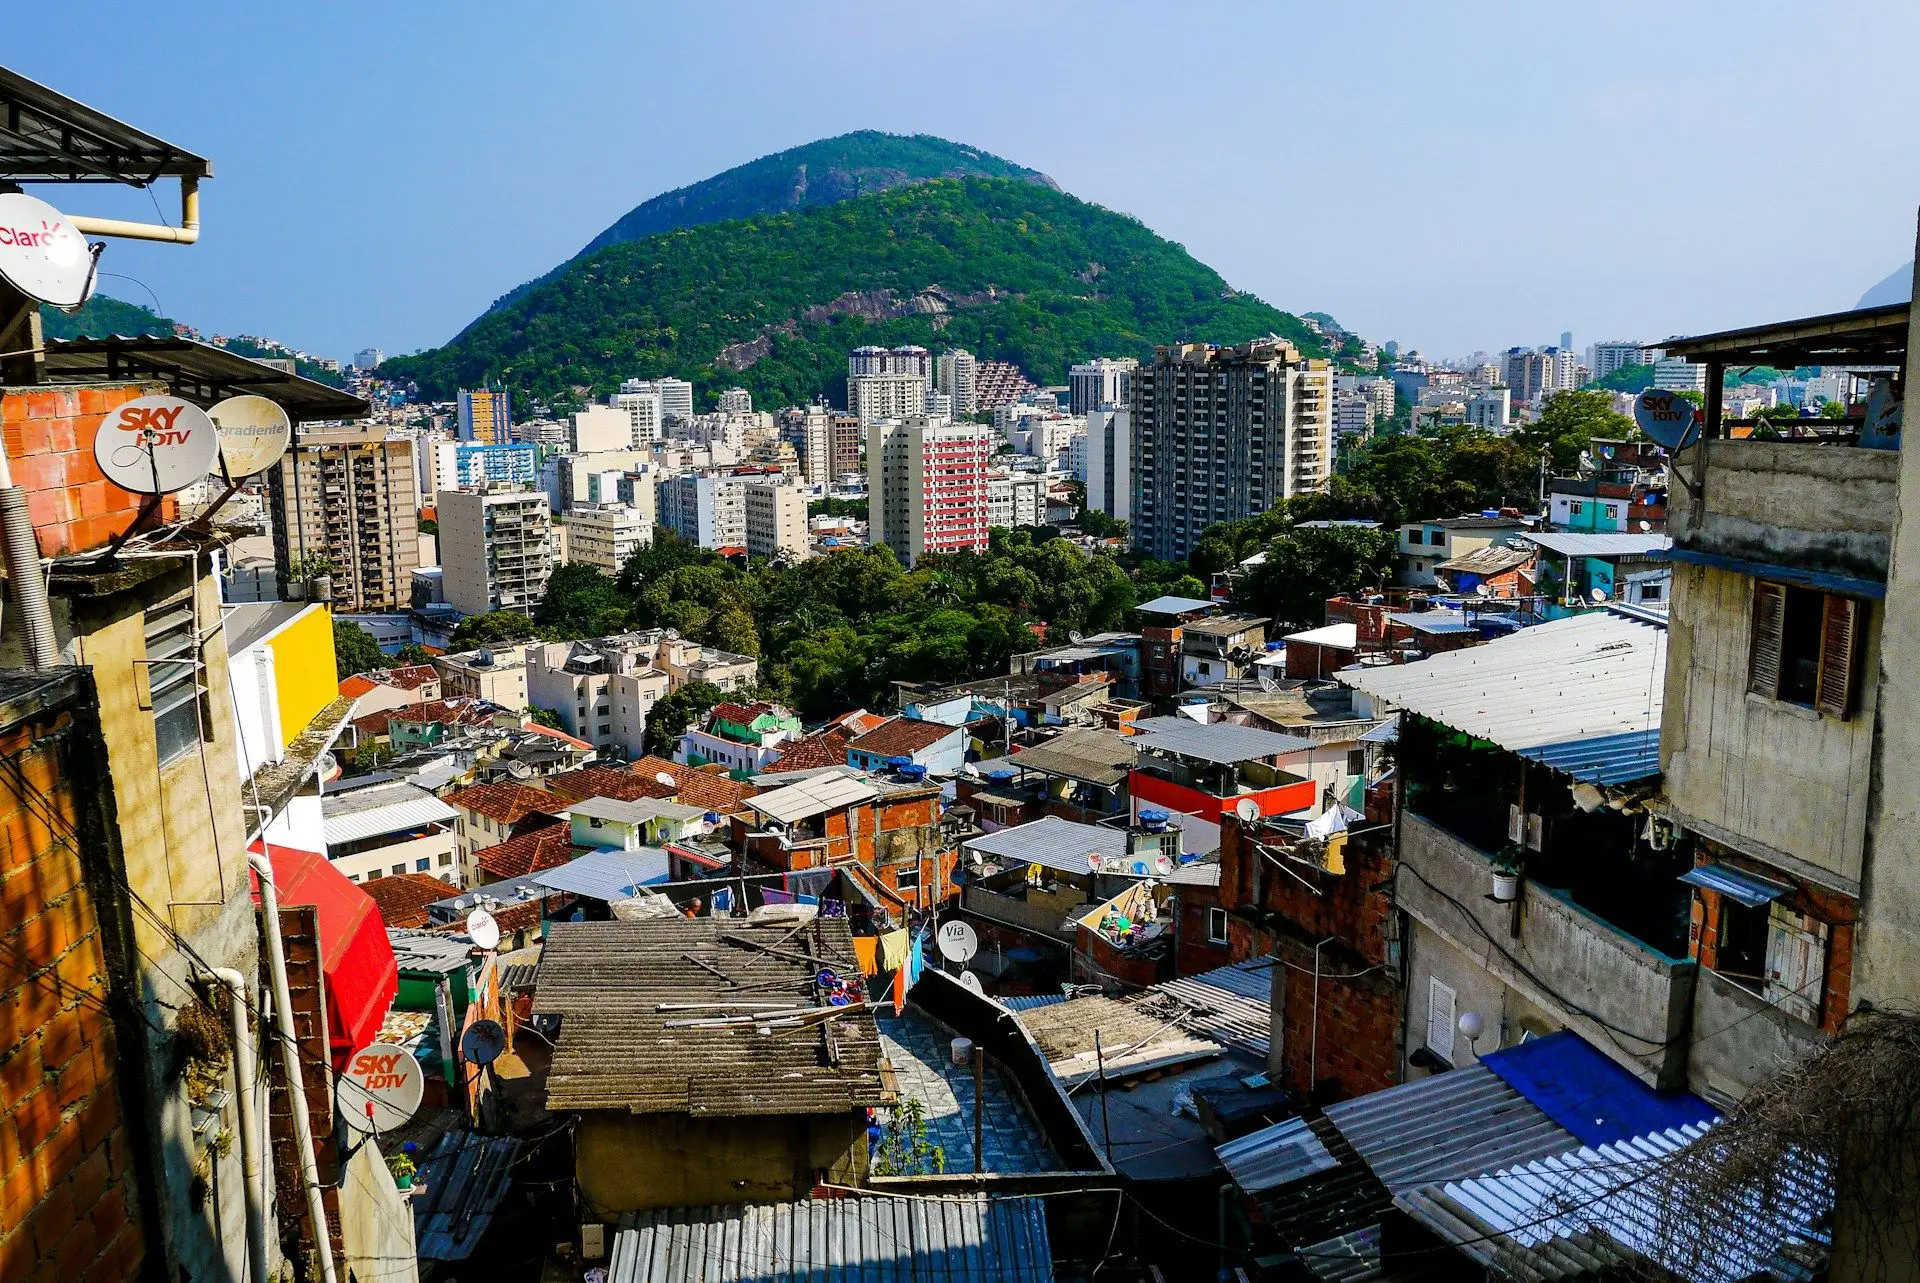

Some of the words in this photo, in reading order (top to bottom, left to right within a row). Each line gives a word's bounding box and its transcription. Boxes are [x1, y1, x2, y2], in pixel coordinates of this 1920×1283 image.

[0, 226, 54, 247] Claro
[1643, 397, 1674, 411] SKY
[117, 405, 185, 432] SKY
[135, 429, 192, 447] HDTV
[220, 424, 285, 437] gradiente
[946, 924, 964, 937] Via
[353, 1053, 403, 1075] SKY
[365, 1073, 408, 1089] HDTV
